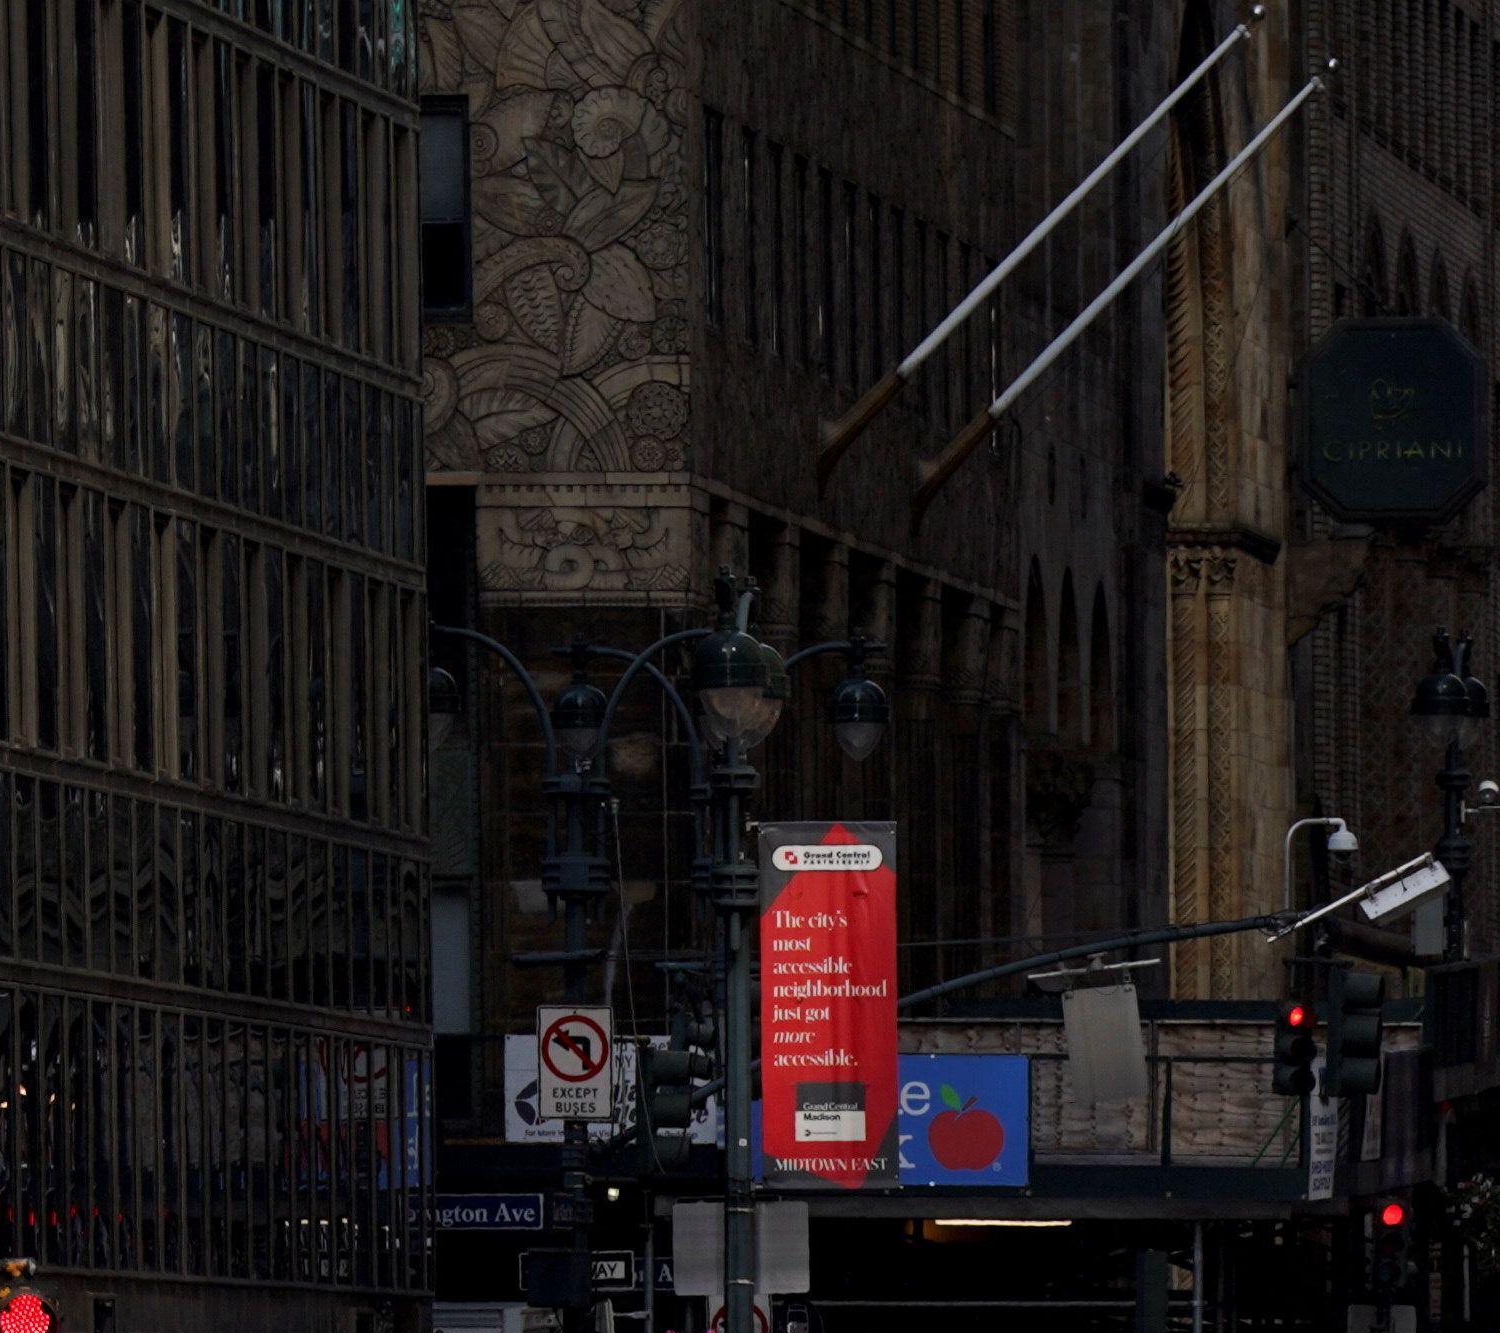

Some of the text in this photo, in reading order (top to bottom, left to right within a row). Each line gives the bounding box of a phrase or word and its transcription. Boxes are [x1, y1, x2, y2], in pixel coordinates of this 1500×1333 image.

[1322, 439, 1463, 462] CIPRIANI
[804, 850, 871, 860] Grand Central
[772, 910, 848, 931] The city's
[772, 937, 812, 952] most
[772, 956, 853, 975] accessible
[772, 979, 888, 1000] neighborhood
[772, 1004, 830, 1024] just got
[772, 1031, 816, 1045] more
[772, 1048, 860, 1068] accessible.
[552, 1087, 599, 1099] EXCEPT
[555, 1101, 597, 1114] BUSES
[803, 1101, 859, 1111] Grand Central
[803, 1112, 841, 1122] Madison
[774, 1158, 888, 1172] MIDTOWN EAST
[494, 1202, 537, 1223] Ave
